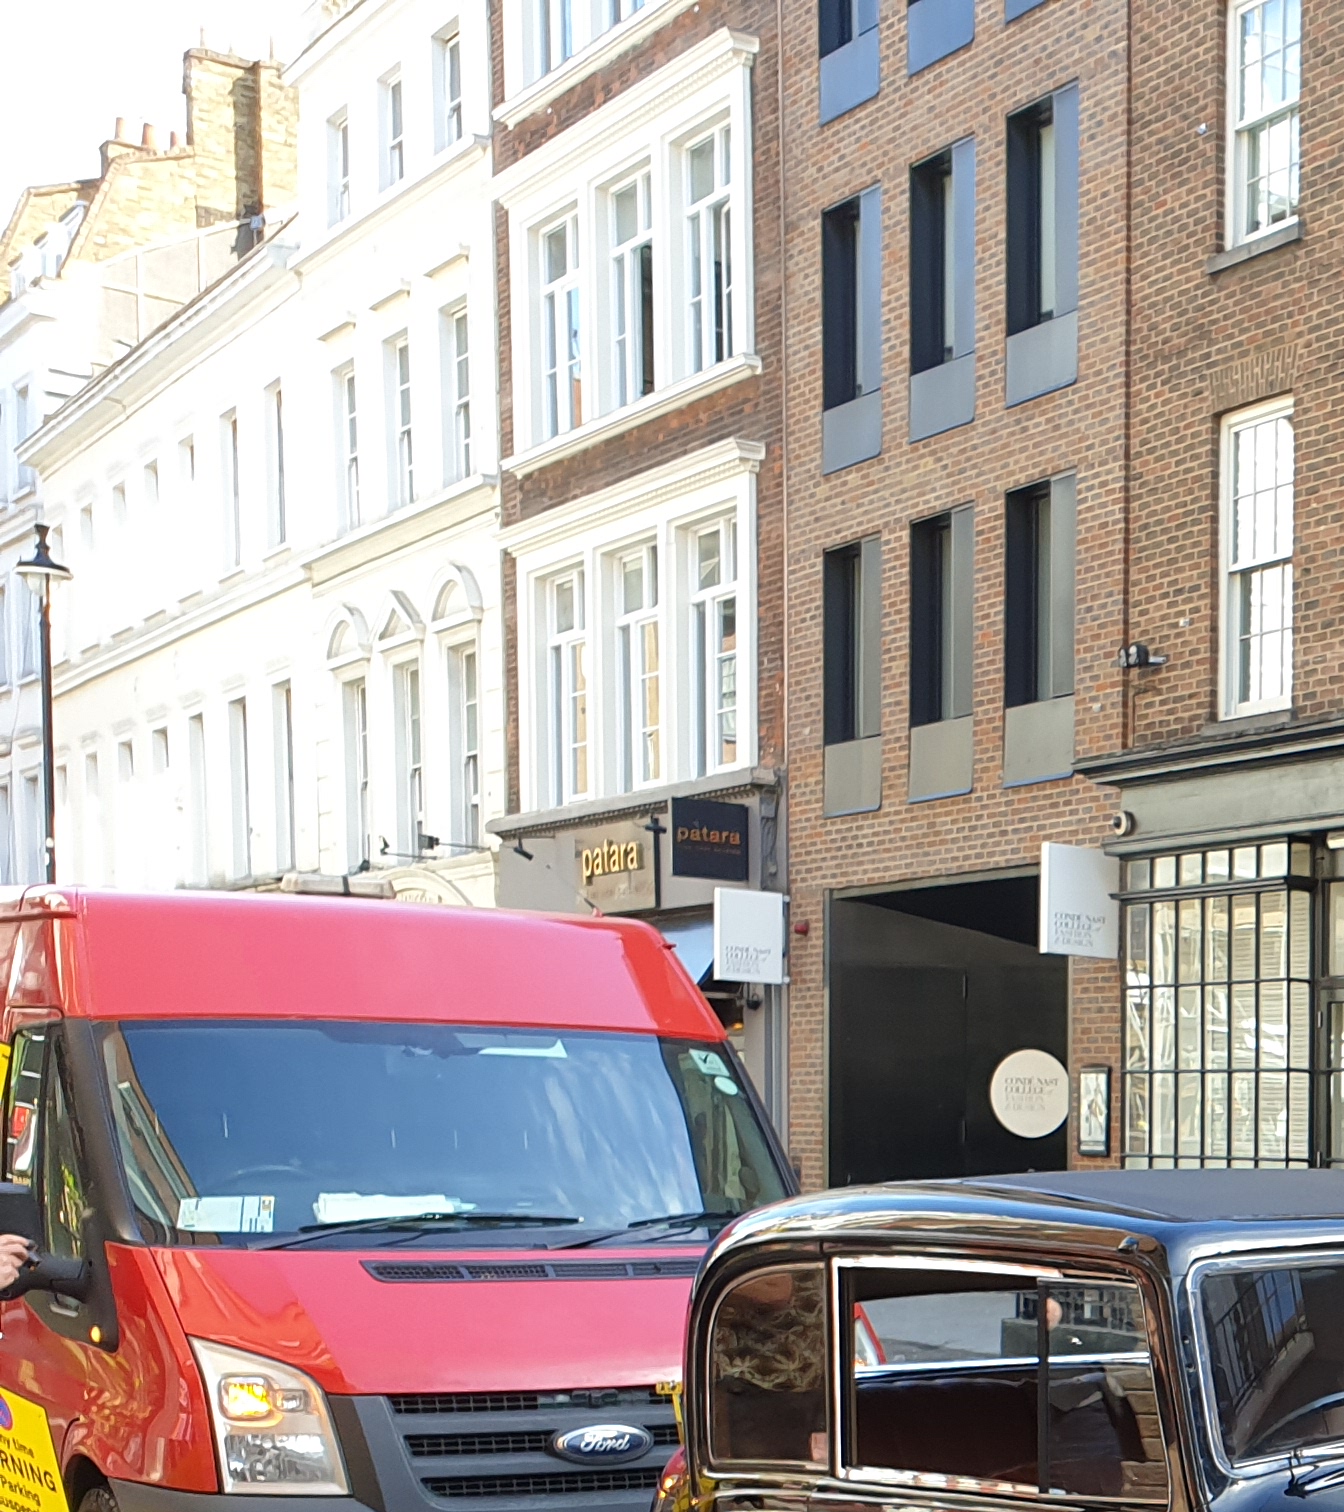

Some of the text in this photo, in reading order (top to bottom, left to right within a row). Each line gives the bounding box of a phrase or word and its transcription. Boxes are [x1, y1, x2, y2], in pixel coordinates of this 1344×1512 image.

[676, 826, 741, 846] patara
[582, 838, 638, 886] patara
[581, 1430, 630, 1452] Ford
[0, 1474, 41, 1506] Parking
